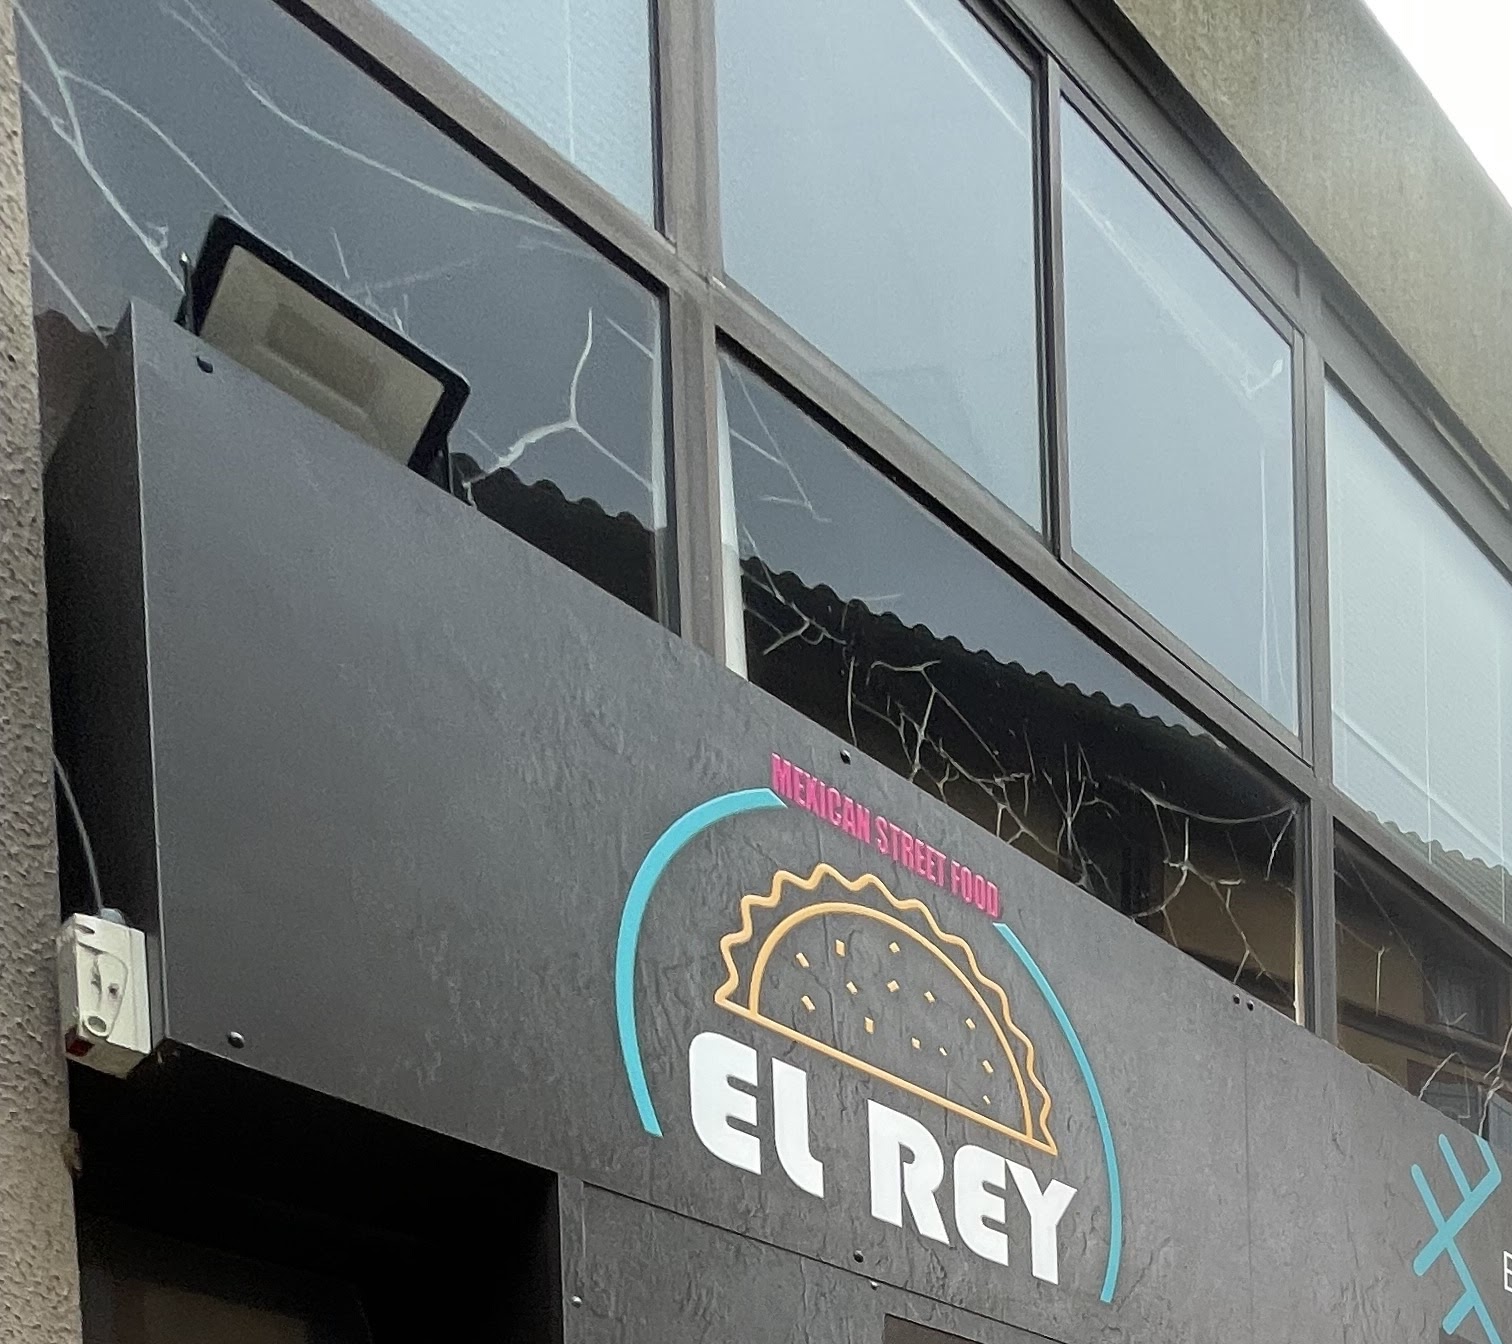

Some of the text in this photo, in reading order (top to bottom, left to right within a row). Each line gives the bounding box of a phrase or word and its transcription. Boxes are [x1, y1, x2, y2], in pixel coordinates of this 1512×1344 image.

[771, 752, 999, 918] MEXICAN STREET FOOD
[689, 1031, 1077, 1285] EL REY
